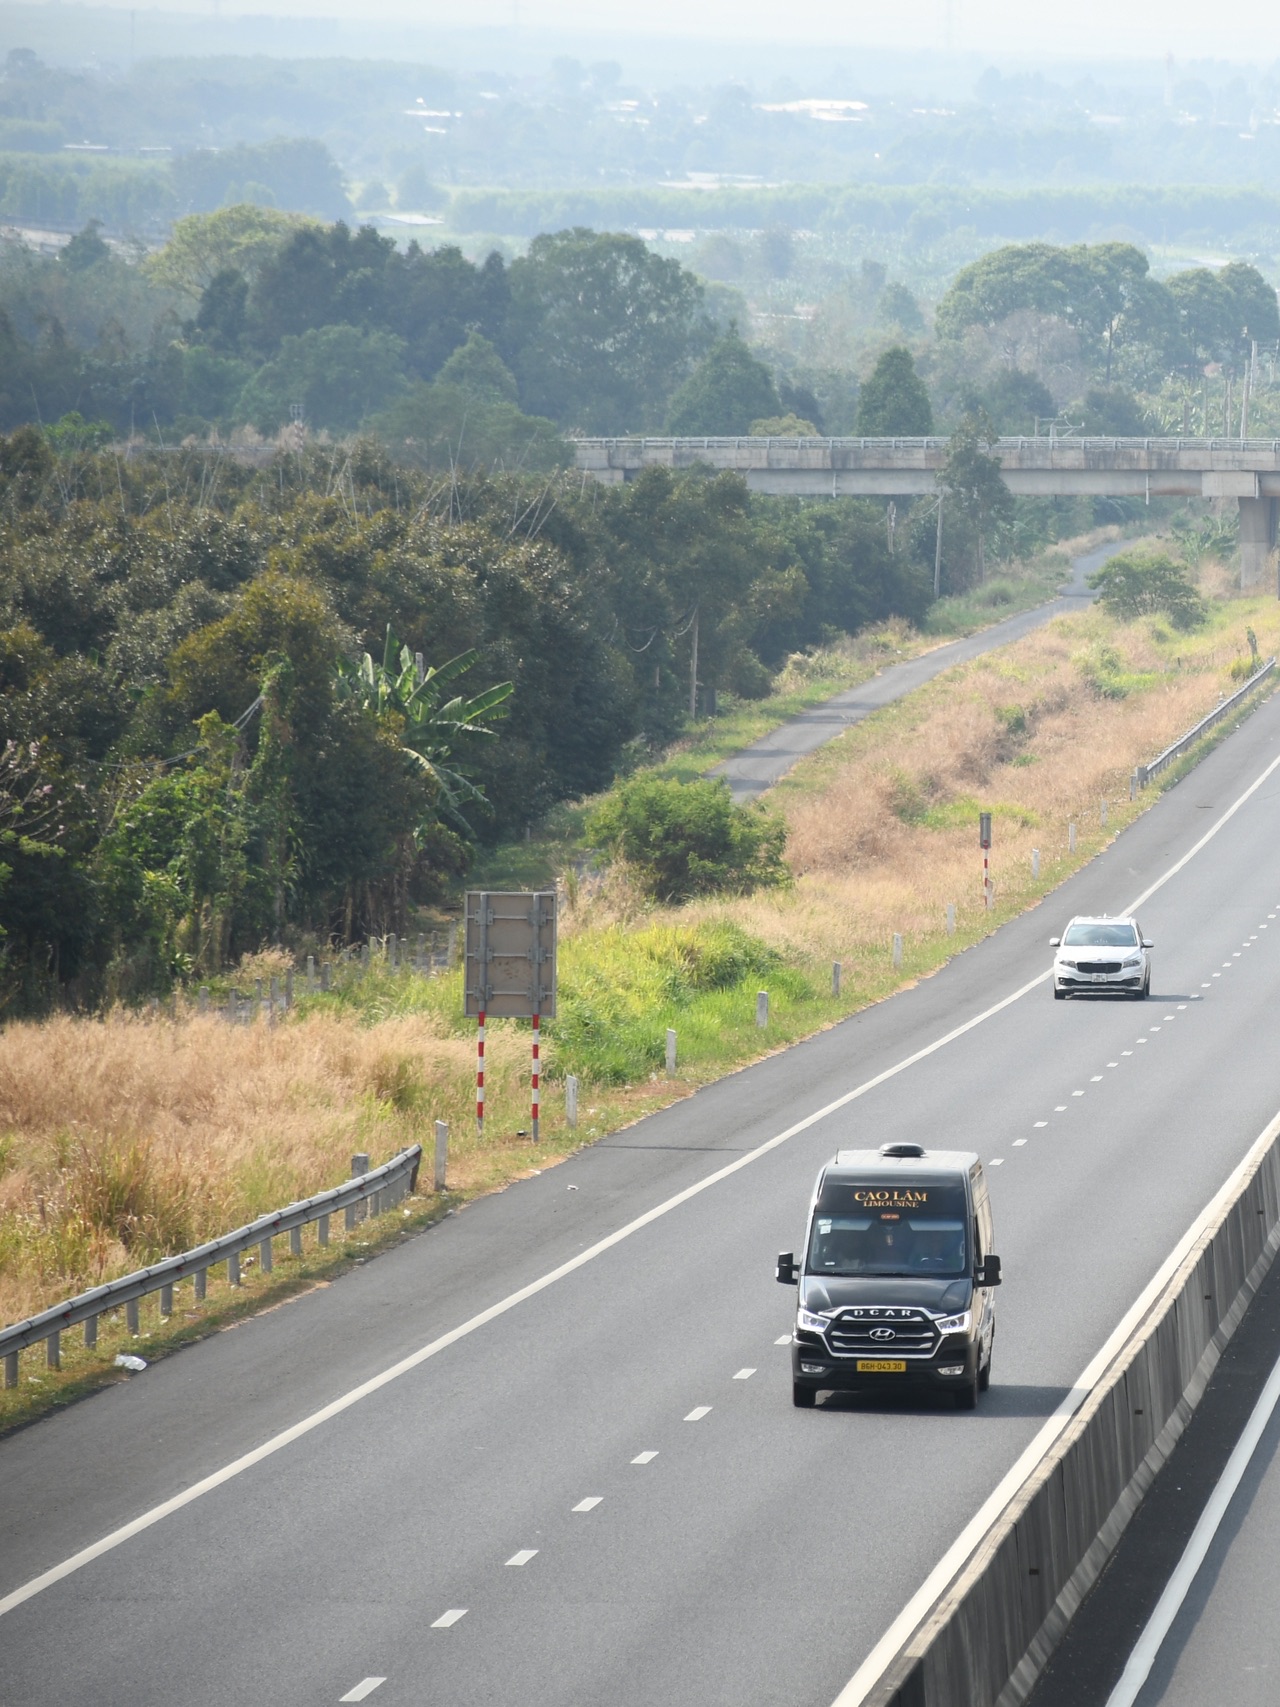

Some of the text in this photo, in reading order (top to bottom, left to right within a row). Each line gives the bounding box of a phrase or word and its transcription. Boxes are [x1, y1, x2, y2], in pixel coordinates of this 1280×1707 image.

[854, 1189, 928, 1202] CAO LÂM
[863, 1200, 919, 1208] LIMOUSINE
